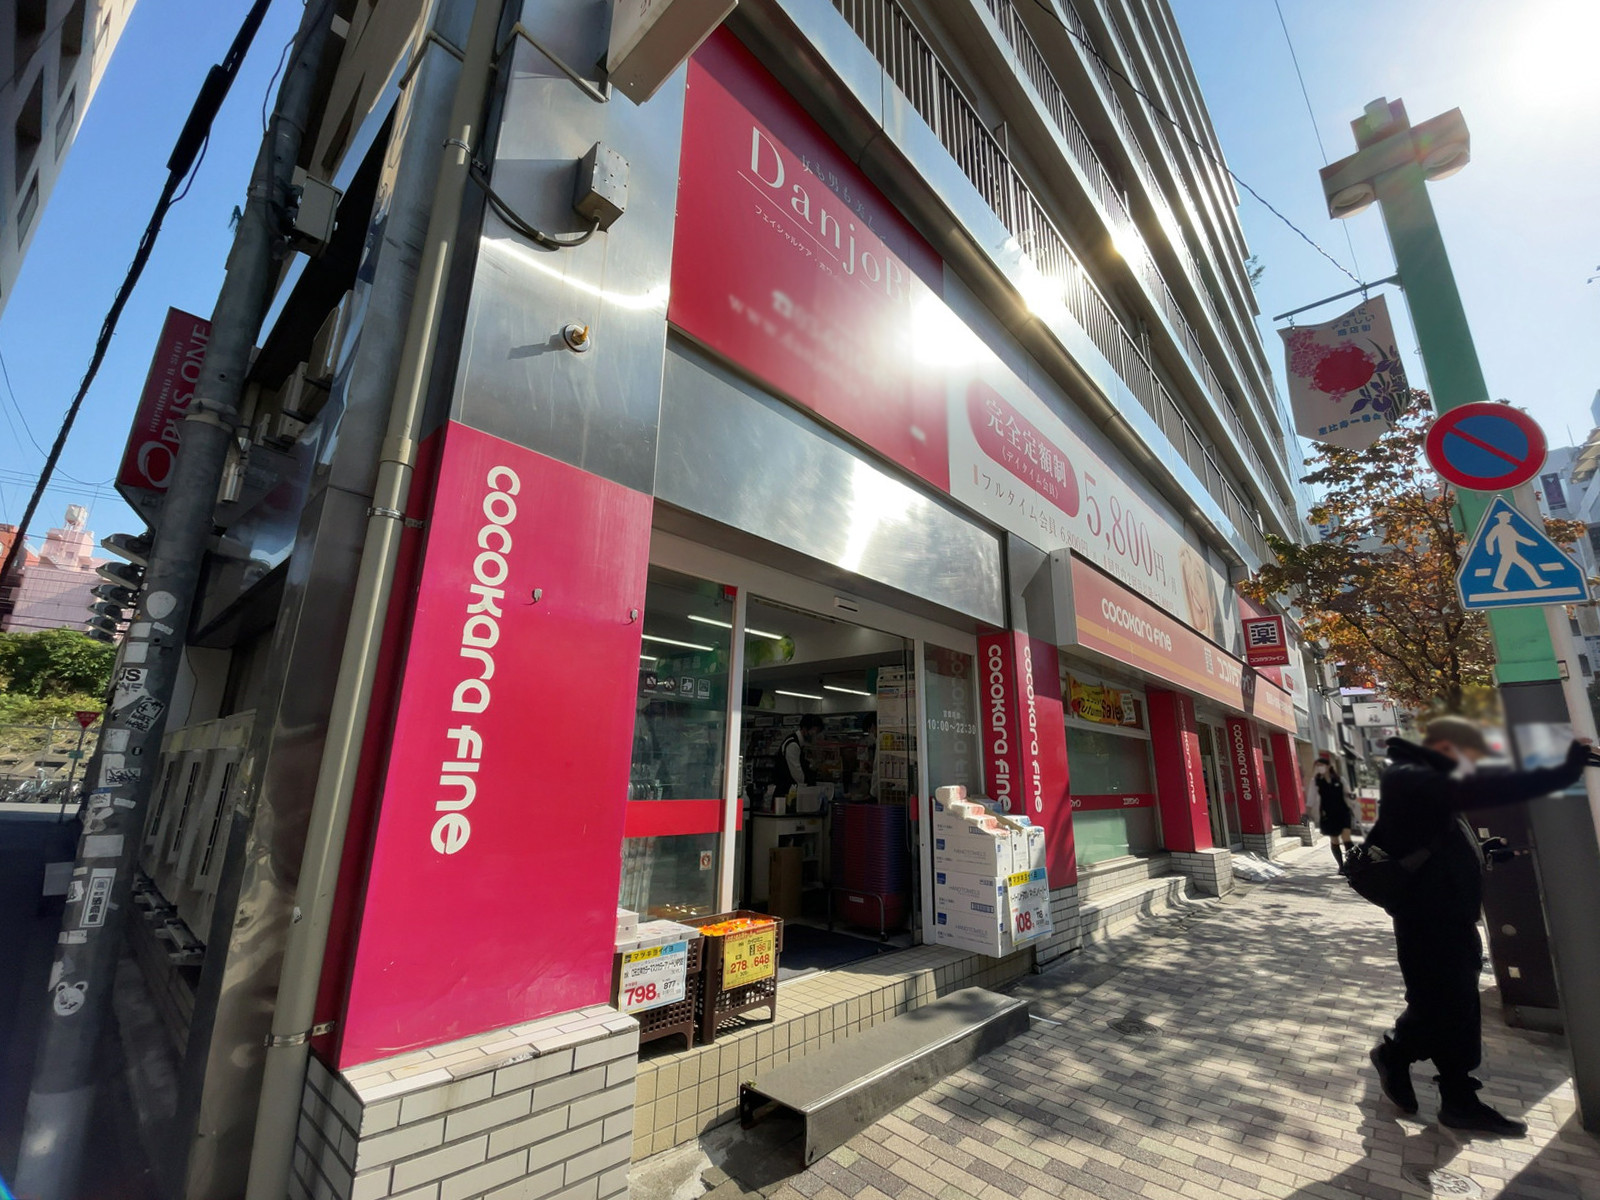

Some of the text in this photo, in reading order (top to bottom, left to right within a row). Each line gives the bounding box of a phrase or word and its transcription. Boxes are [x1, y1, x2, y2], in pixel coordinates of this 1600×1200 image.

[985, 399, 1067, 488] 完全定額制
[451, 465, 521, 713] cocokara
[1250, 622, 1278, 646] 薬
[730, 960, 747, 973] 278
[753, 954, 770, 967] 648
[624, 983, 657, 1006] 798
